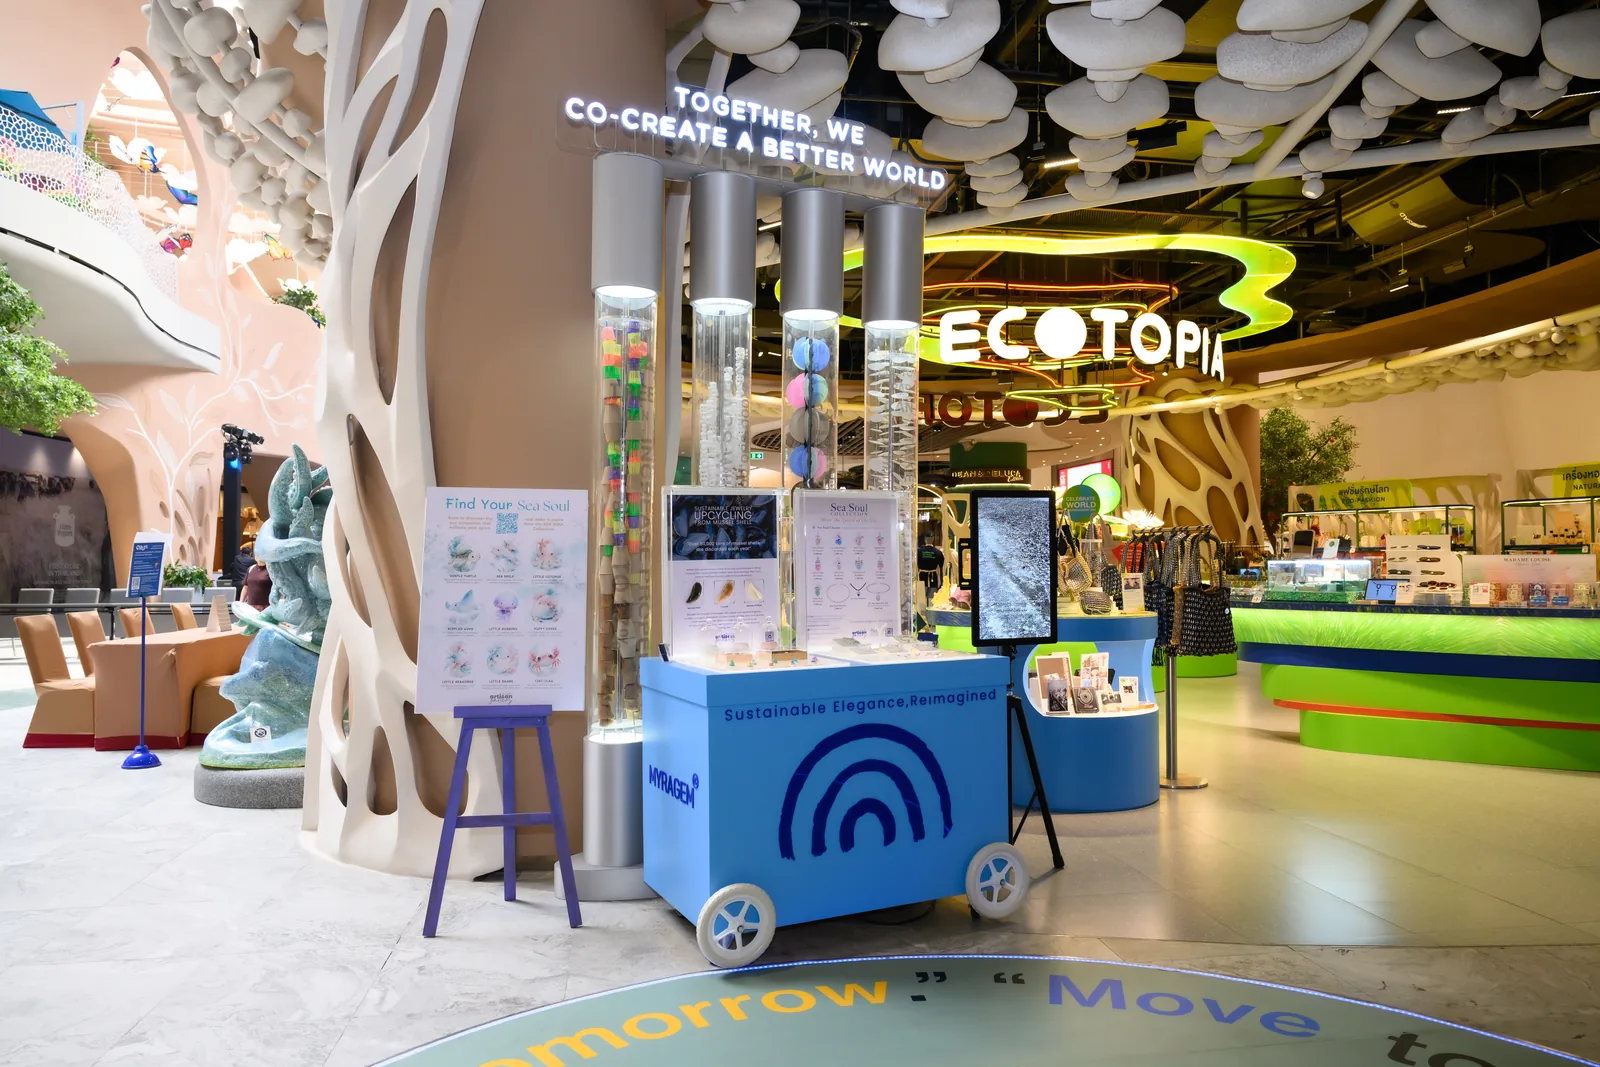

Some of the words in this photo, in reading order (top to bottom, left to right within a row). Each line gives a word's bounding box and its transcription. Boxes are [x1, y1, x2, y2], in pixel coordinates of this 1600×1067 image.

[674, 86, 818, 139] TOGETHER,
[827, 118, 865, 146] WE
[565, 97, 728, 148] CO-CREATE
[736, 130, 754, 153] A
[763, 136, 855, 172] BETTER
[863, 156, 947, 190] WORLD
[939, 306, 1225, 382] ECOTOPIA
[446, 497, 476, 510] Find
[481, 499, 513, 511] Your
[517, 500, 540, 512] Sea
[542, 499, 570, 512] Soul
[830, 502, 846, 512] Sea
[848, 503, 868, 513] Soul
[1066, 501, 1097, 509] WORLD
[694, 511, 752, 520] UPCYCLING
[724, 702, 827, 722] Sustainable
